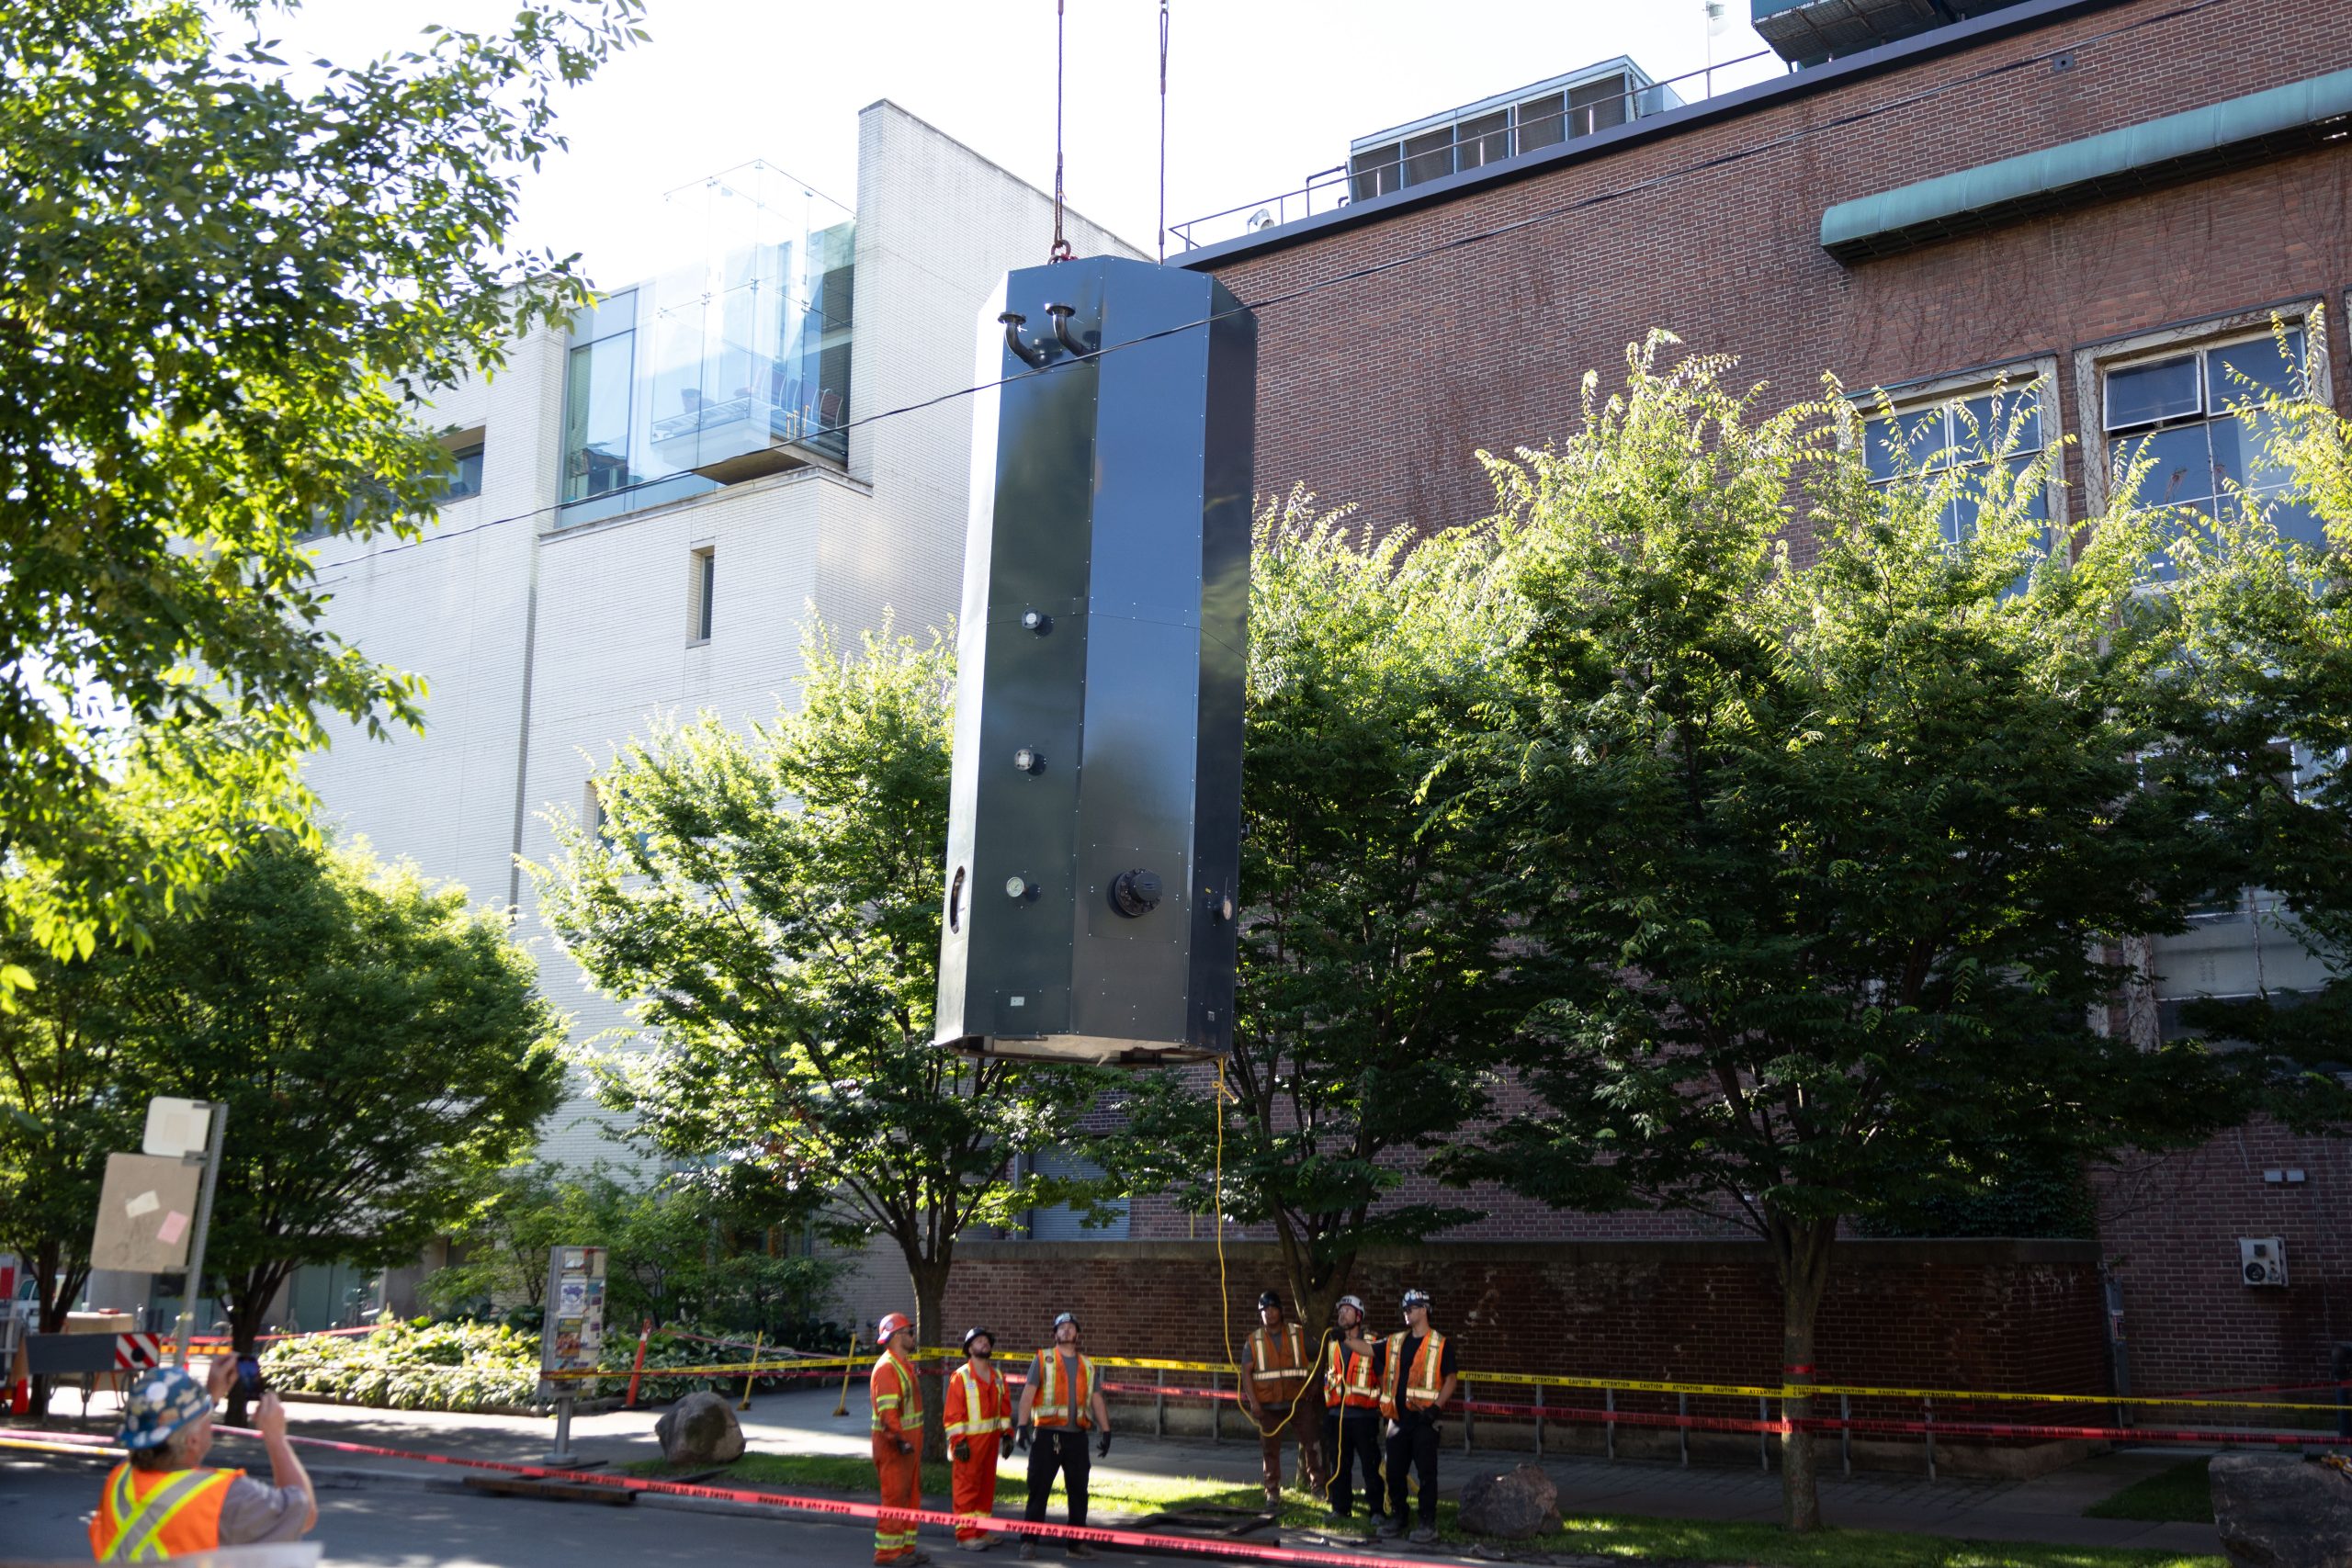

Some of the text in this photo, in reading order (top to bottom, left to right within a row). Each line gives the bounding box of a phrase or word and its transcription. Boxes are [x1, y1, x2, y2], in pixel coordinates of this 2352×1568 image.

[1464, 1372, 1493, 1382] ATTENTION
[1500, 1374, 1522, 1382] CAUTION
[1531, 1376, 1560, 1384] ATTENTION
[1568, 1378, 1591, 1386] CAUTION
[1600, 1381, 1630, 1389] ATTENTION
[1639, 1382, 1663, 1391] CAUTION
[1672, 1384, 1703, 1393] ATTENTION
